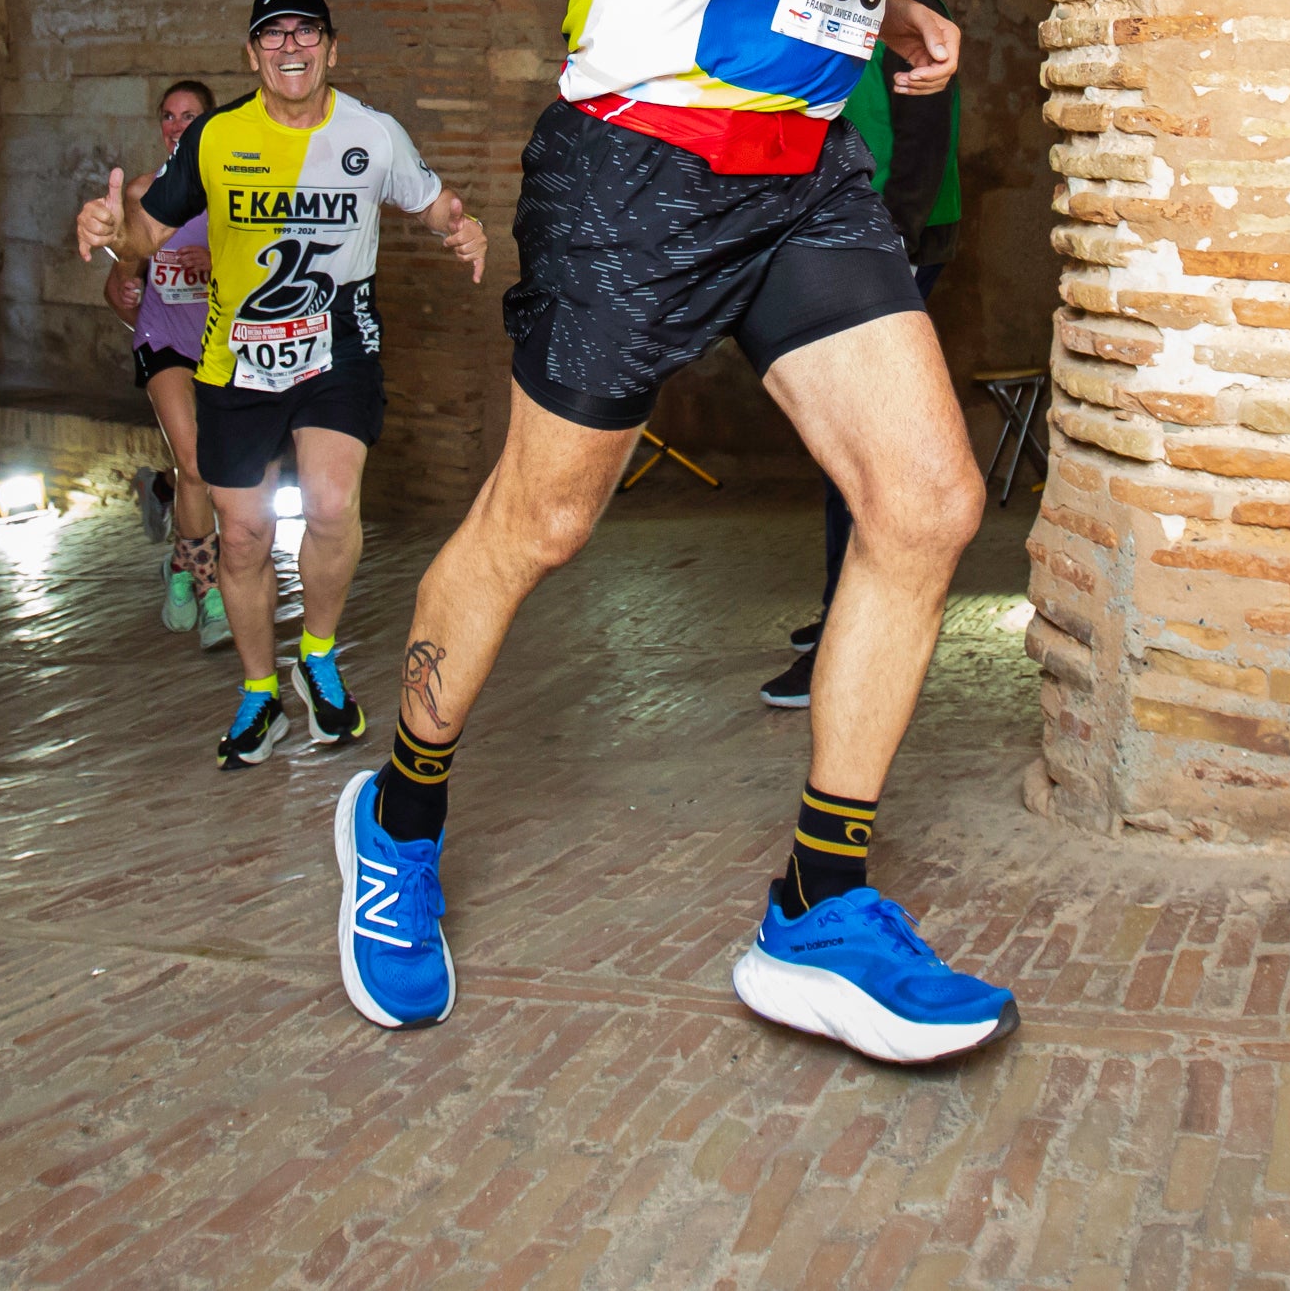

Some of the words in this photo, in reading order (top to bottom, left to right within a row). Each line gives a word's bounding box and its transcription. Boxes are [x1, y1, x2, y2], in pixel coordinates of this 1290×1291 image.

[228, 189, 359, 225] E.KAMYR
[273, 227, 291, 236] 1999
[298, 227, 317, 236] 2024
[236, 238, 345, 322] 25
[234, 324, 248, 341] 40
[237, 335, 318, 371] 1057
[805, 936, 844, 952] balance
